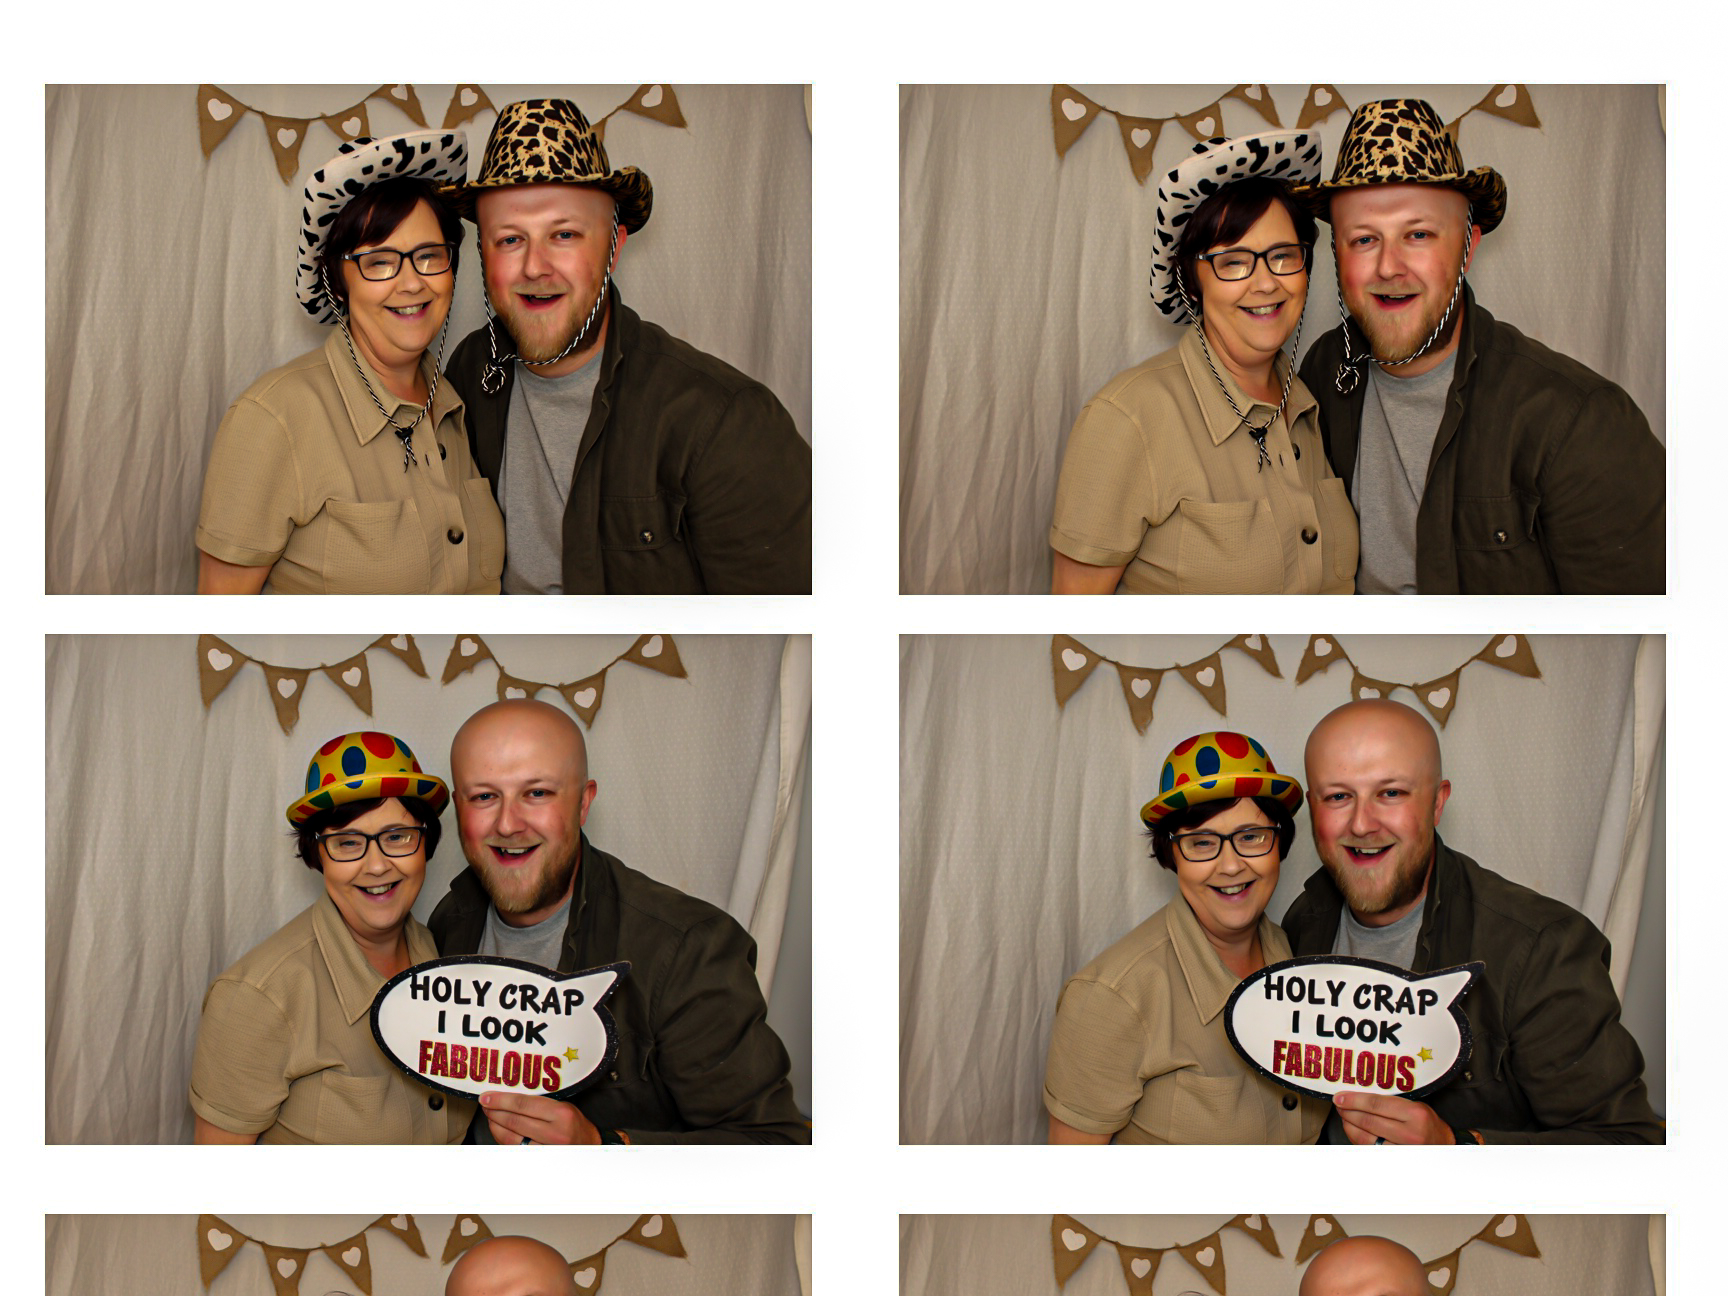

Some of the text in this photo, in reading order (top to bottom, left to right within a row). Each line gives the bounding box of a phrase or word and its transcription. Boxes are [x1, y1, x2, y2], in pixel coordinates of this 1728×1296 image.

[410, 974, 584, 1016] HOLY CRAP
[1264, 974, 1438, 1016] HOLY CRAP
[438, 1010, 549, 1046] I LOOK
[1292, 1010, 1403, 1046] I LOOK
[418, 1040, 562, 1092] FABULOUS
[1272, 1040, 1416, 1092] FABULOUS
